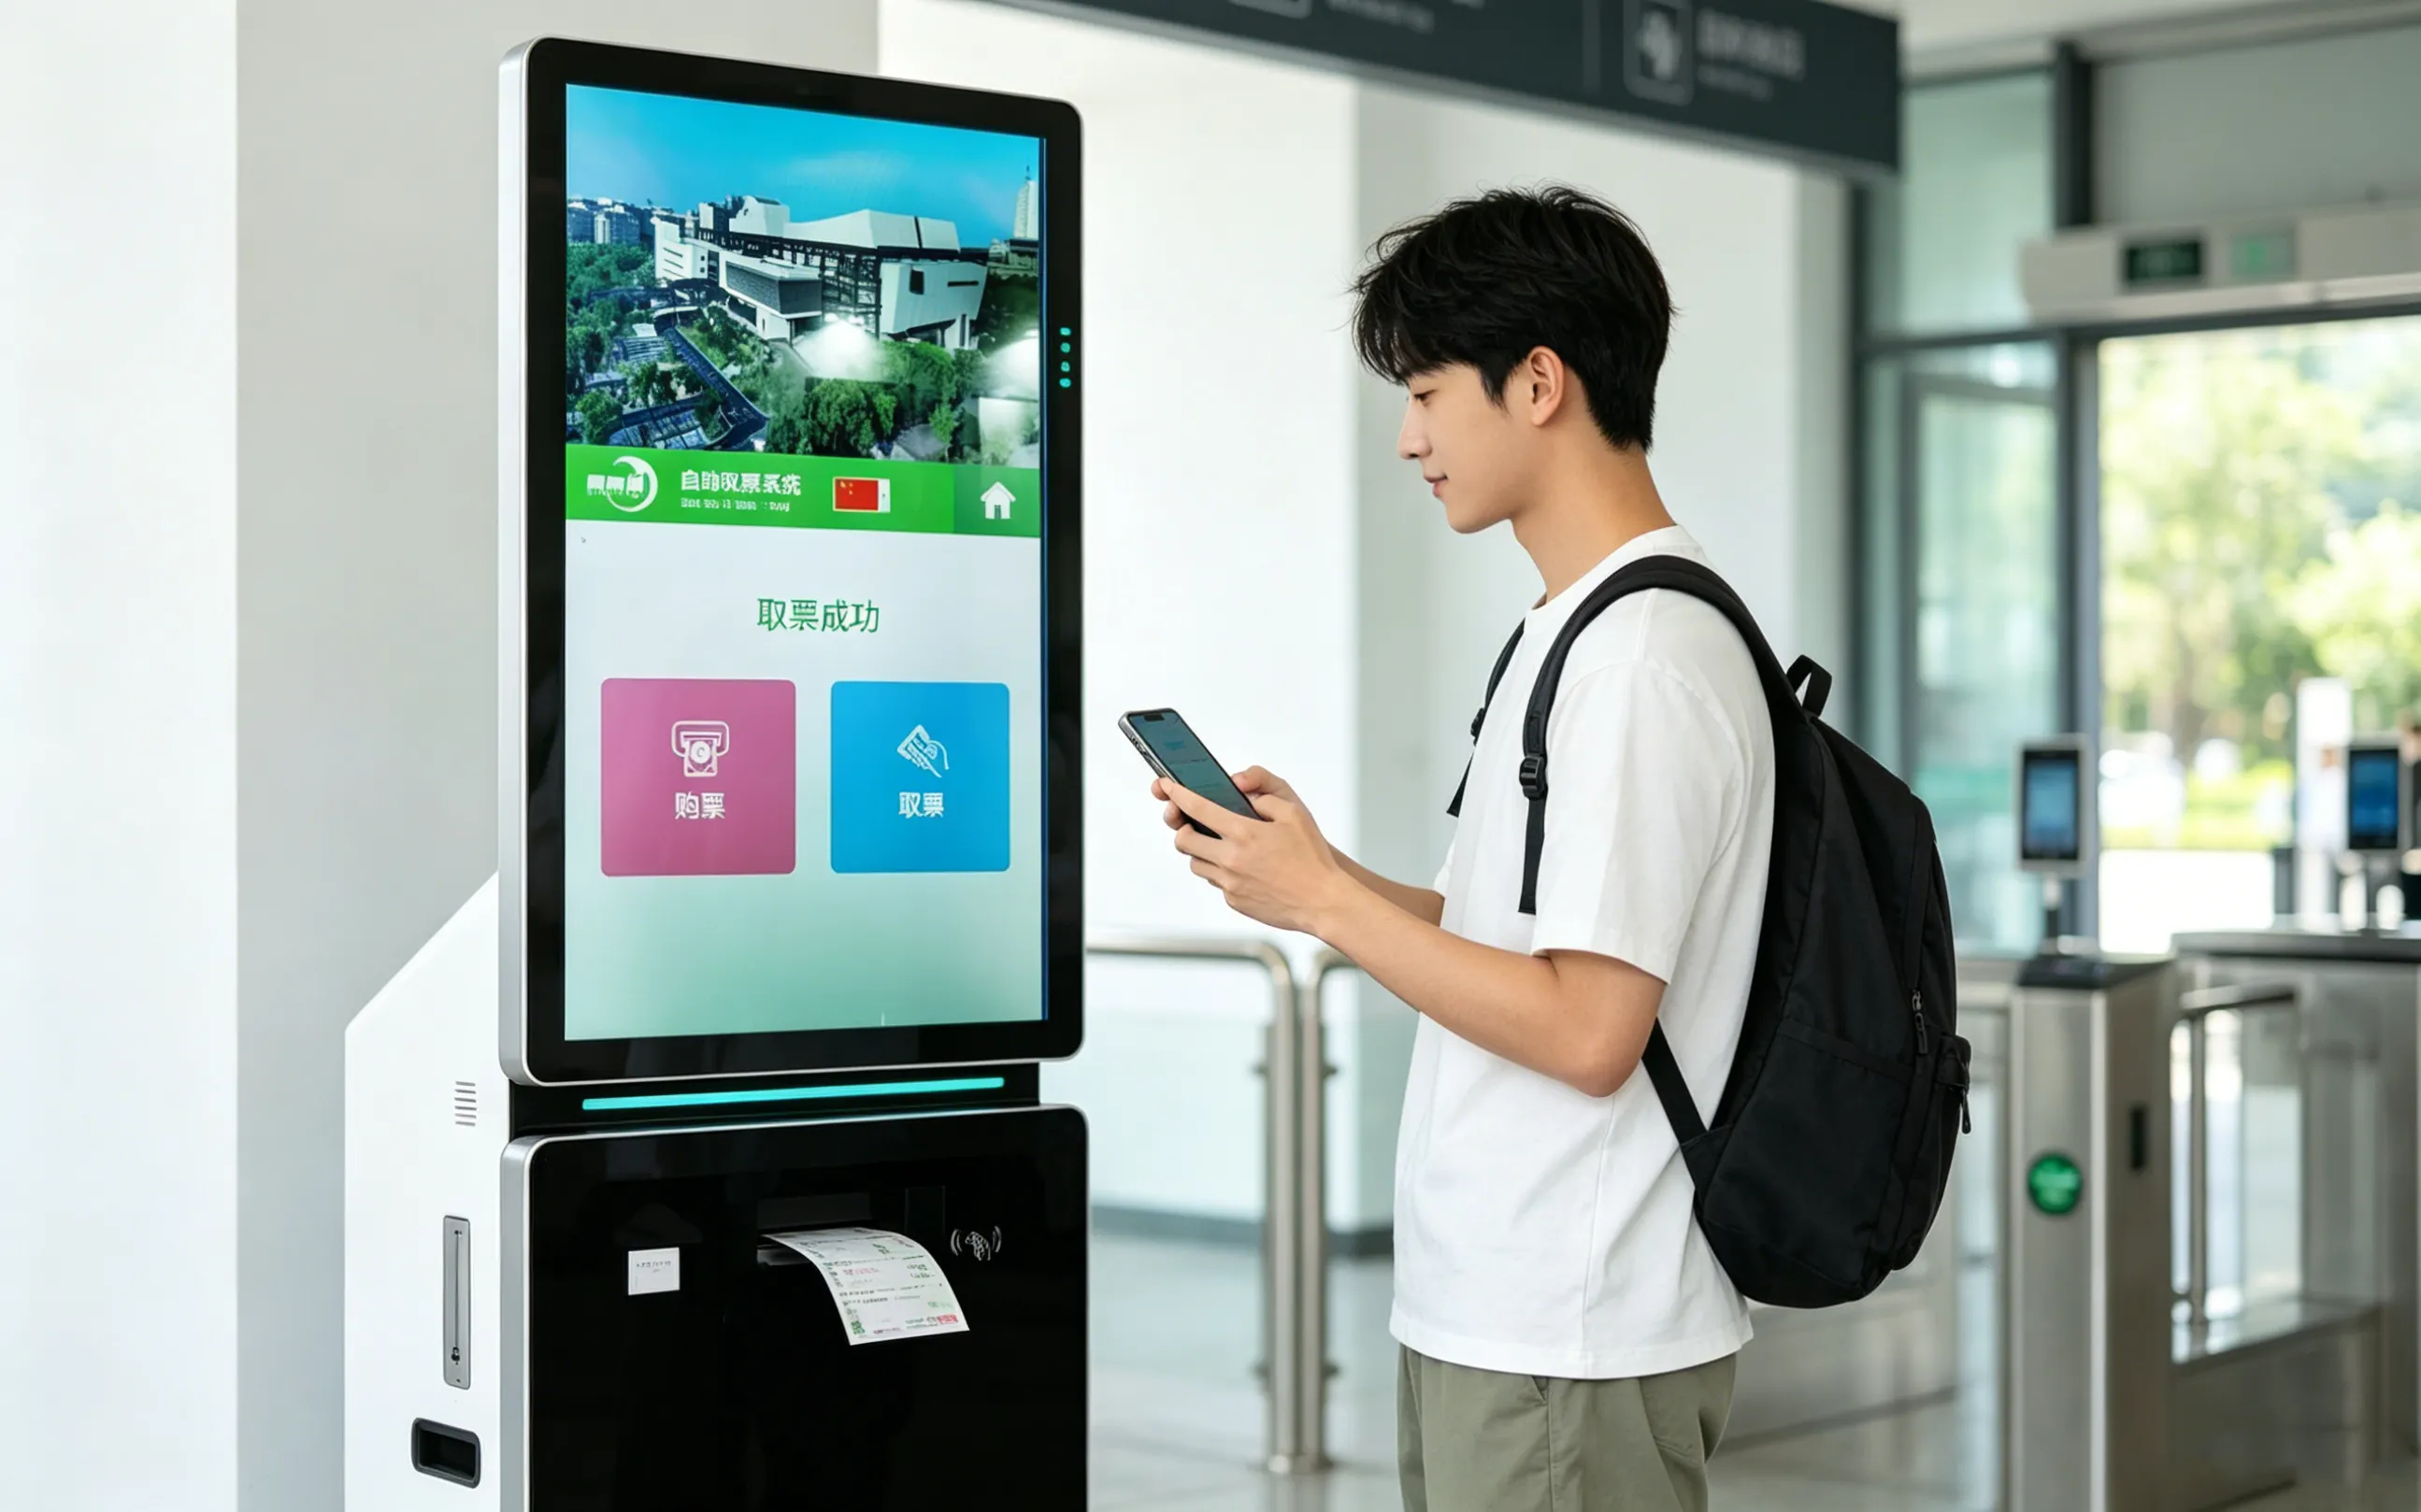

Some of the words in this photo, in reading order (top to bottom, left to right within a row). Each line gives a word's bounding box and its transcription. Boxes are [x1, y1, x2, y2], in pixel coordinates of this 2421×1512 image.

[756, 598, 880, 634] 取票成功
[674, 791, 726, 820] 购票
[897, 791, 945, 820] 取票
